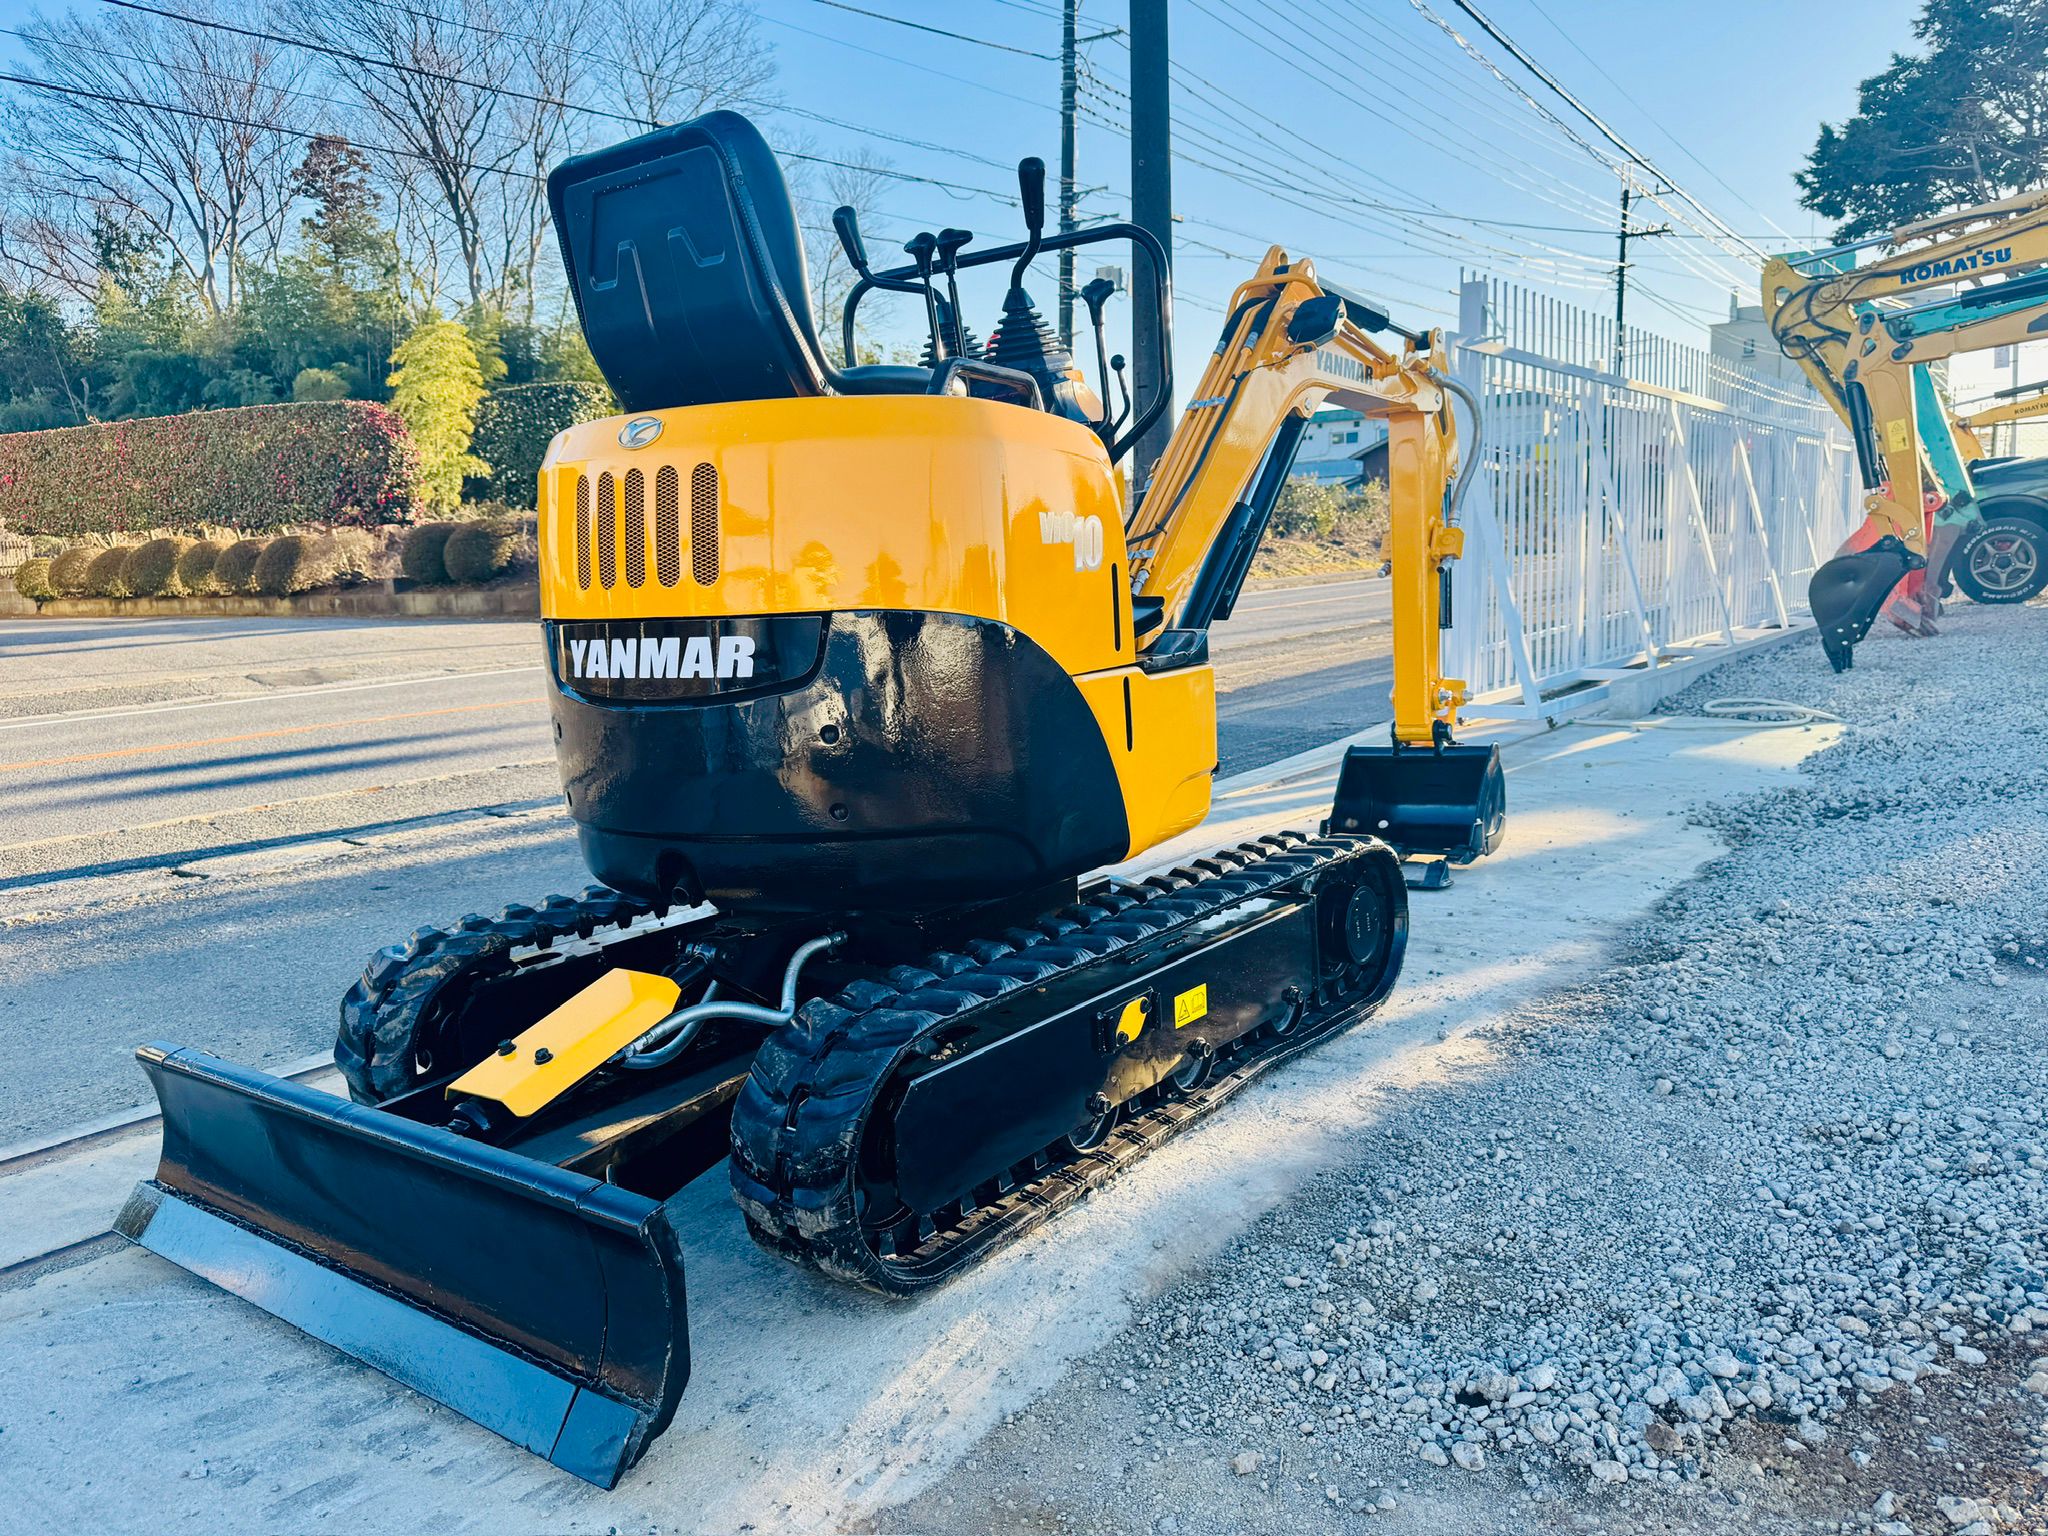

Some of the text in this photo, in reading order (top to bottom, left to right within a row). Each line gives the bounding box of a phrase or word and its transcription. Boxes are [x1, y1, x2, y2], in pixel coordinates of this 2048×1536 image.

[1900, 247, 2012, 285] KOMATSU
[1316, 350, 1374, 385] YANMAR
[570, 636, 756, 679] YANMAR
